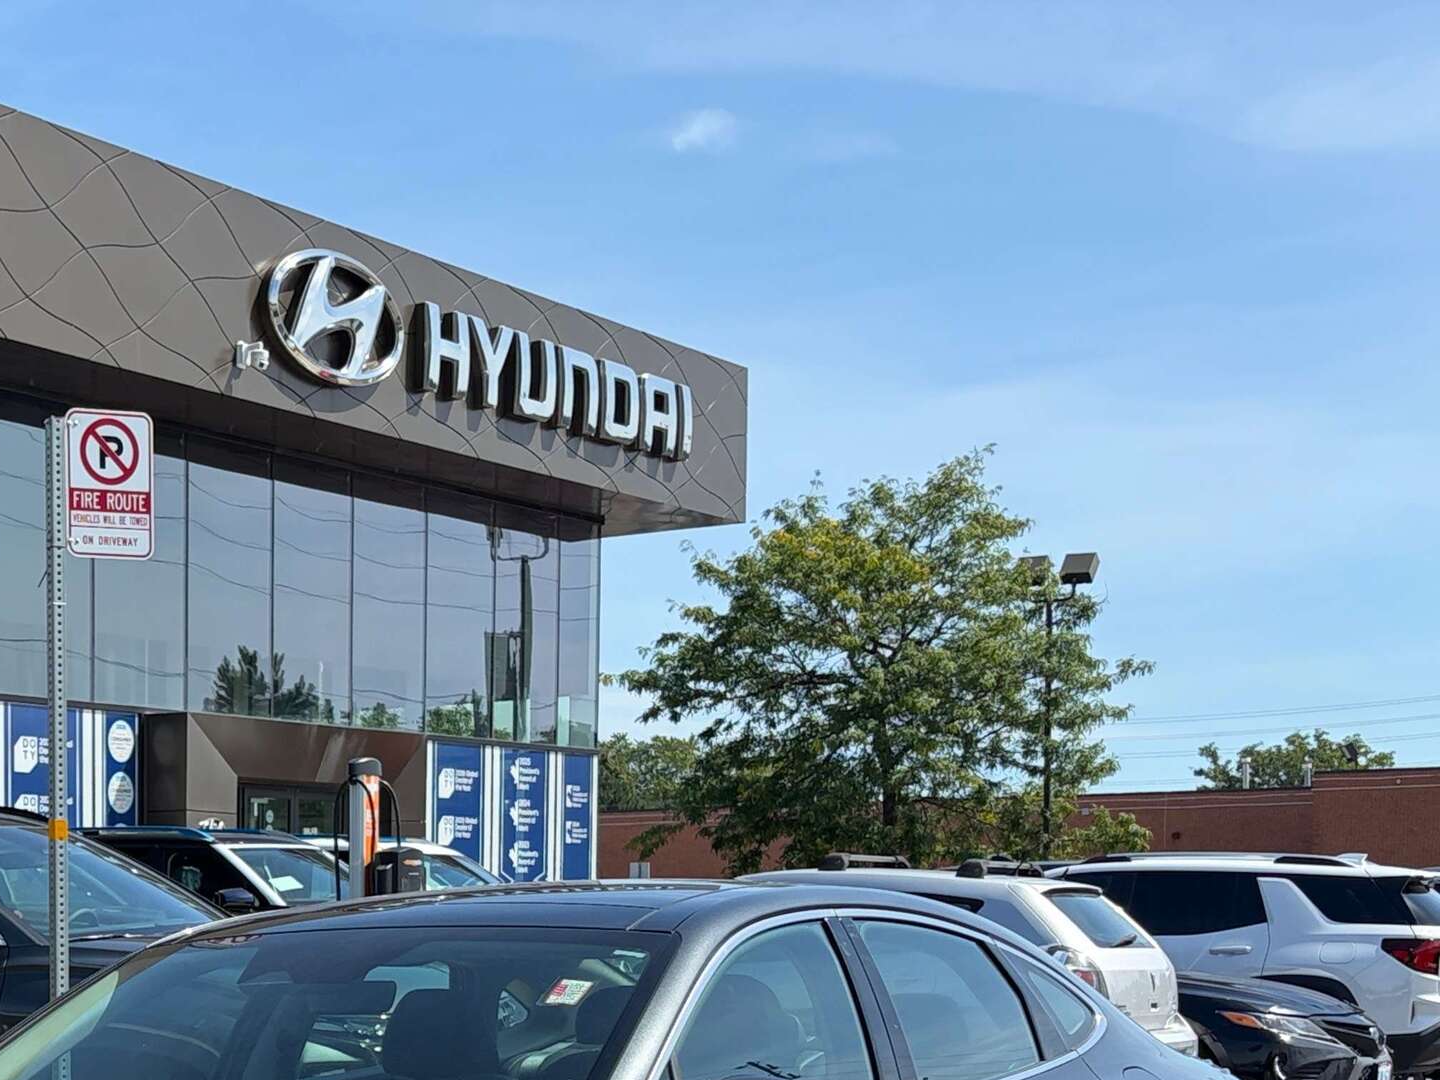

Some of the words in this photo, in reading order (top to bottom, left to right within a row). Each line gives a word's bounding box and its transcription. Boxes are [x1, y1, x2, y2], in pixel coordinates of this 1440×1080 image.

[415, 300, 694, 462] HYUNDAI
[73, 490, 101, 509] FIRE
[106, 492, 147, 512] ROUTE
[73, 513, 100, 524] VEHICLES
[103, 515, 116, 525] WILL
[119, 516, 127, 526] BE
[129, 517, 148, 527] TOWED
[82, 535, 94, 545] ON
[98, 535, 139, 547] DRIVEWAY
